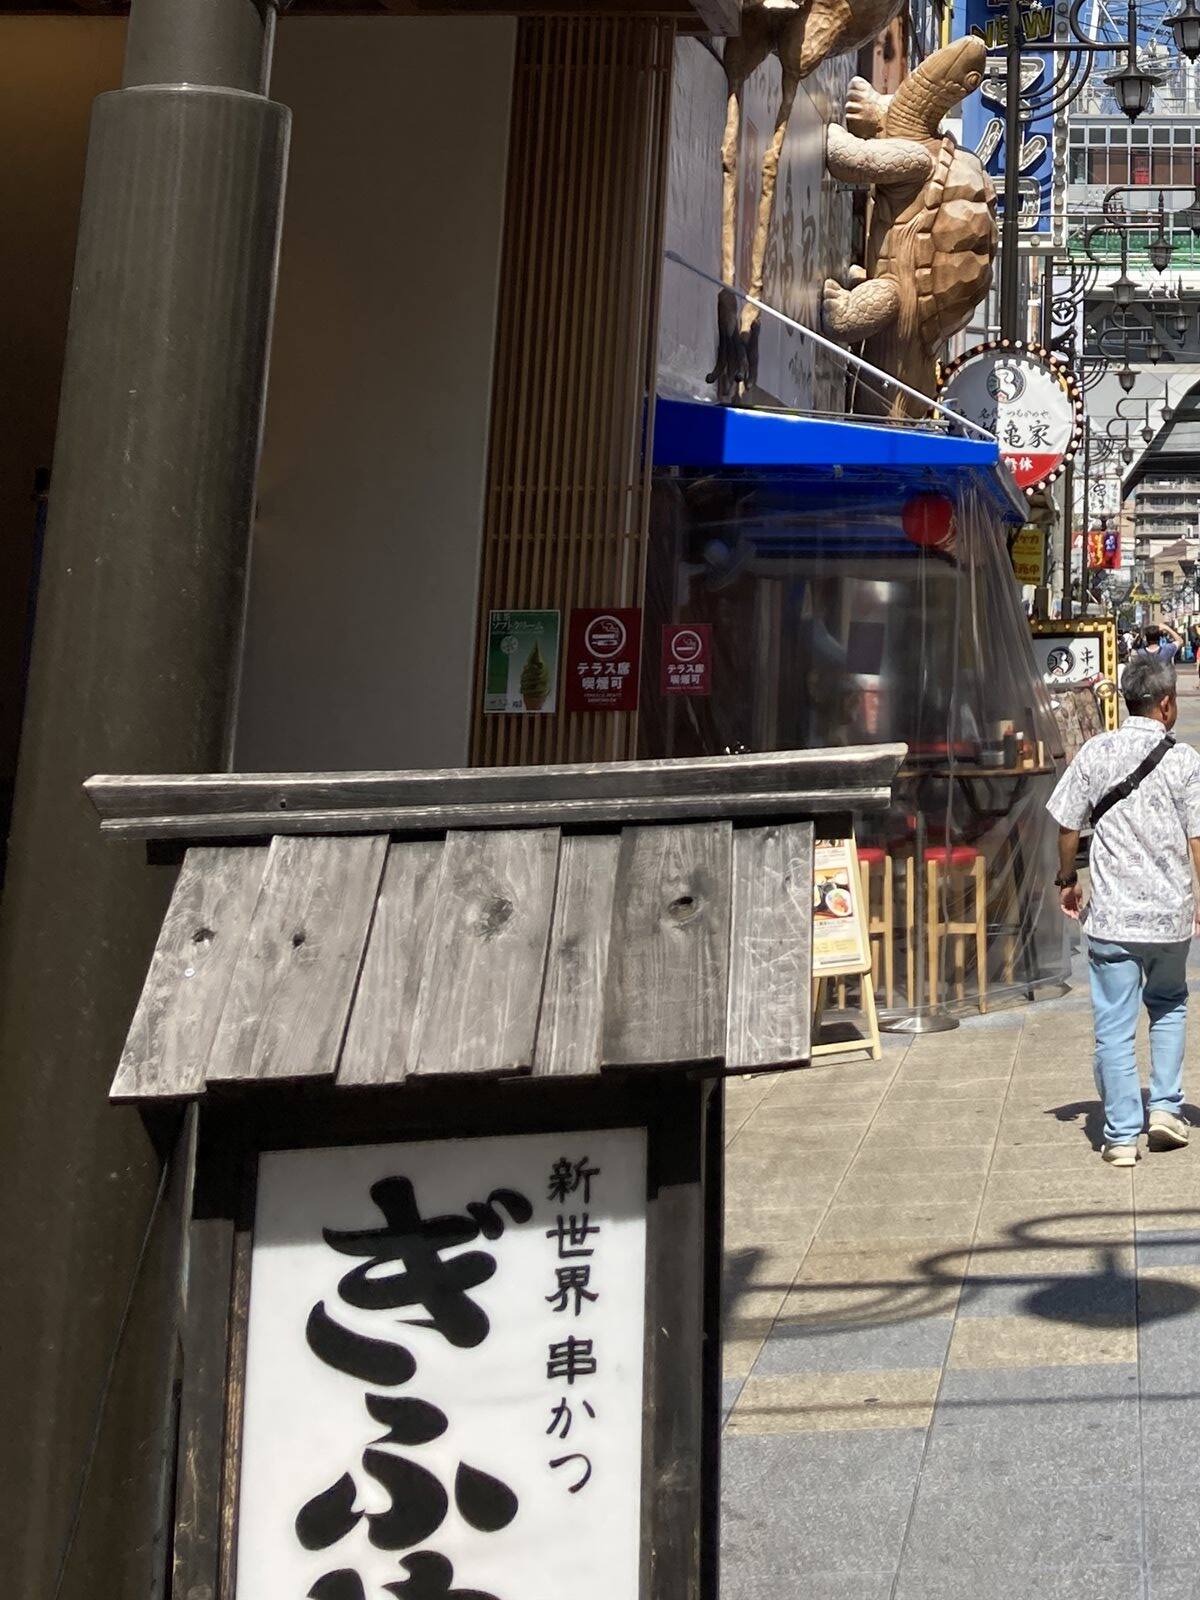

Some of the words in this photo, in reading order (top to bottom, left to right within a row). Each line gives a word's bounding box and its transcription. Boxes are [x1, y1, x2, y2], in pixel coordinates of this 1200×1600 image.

[576, 662, 631, 676] テラス席
[546, 1155, 600, 1317] 新世界
[294, 1175, 535, 1600] ぎふ
[545, 1334, 599, 1494] 串かつ
